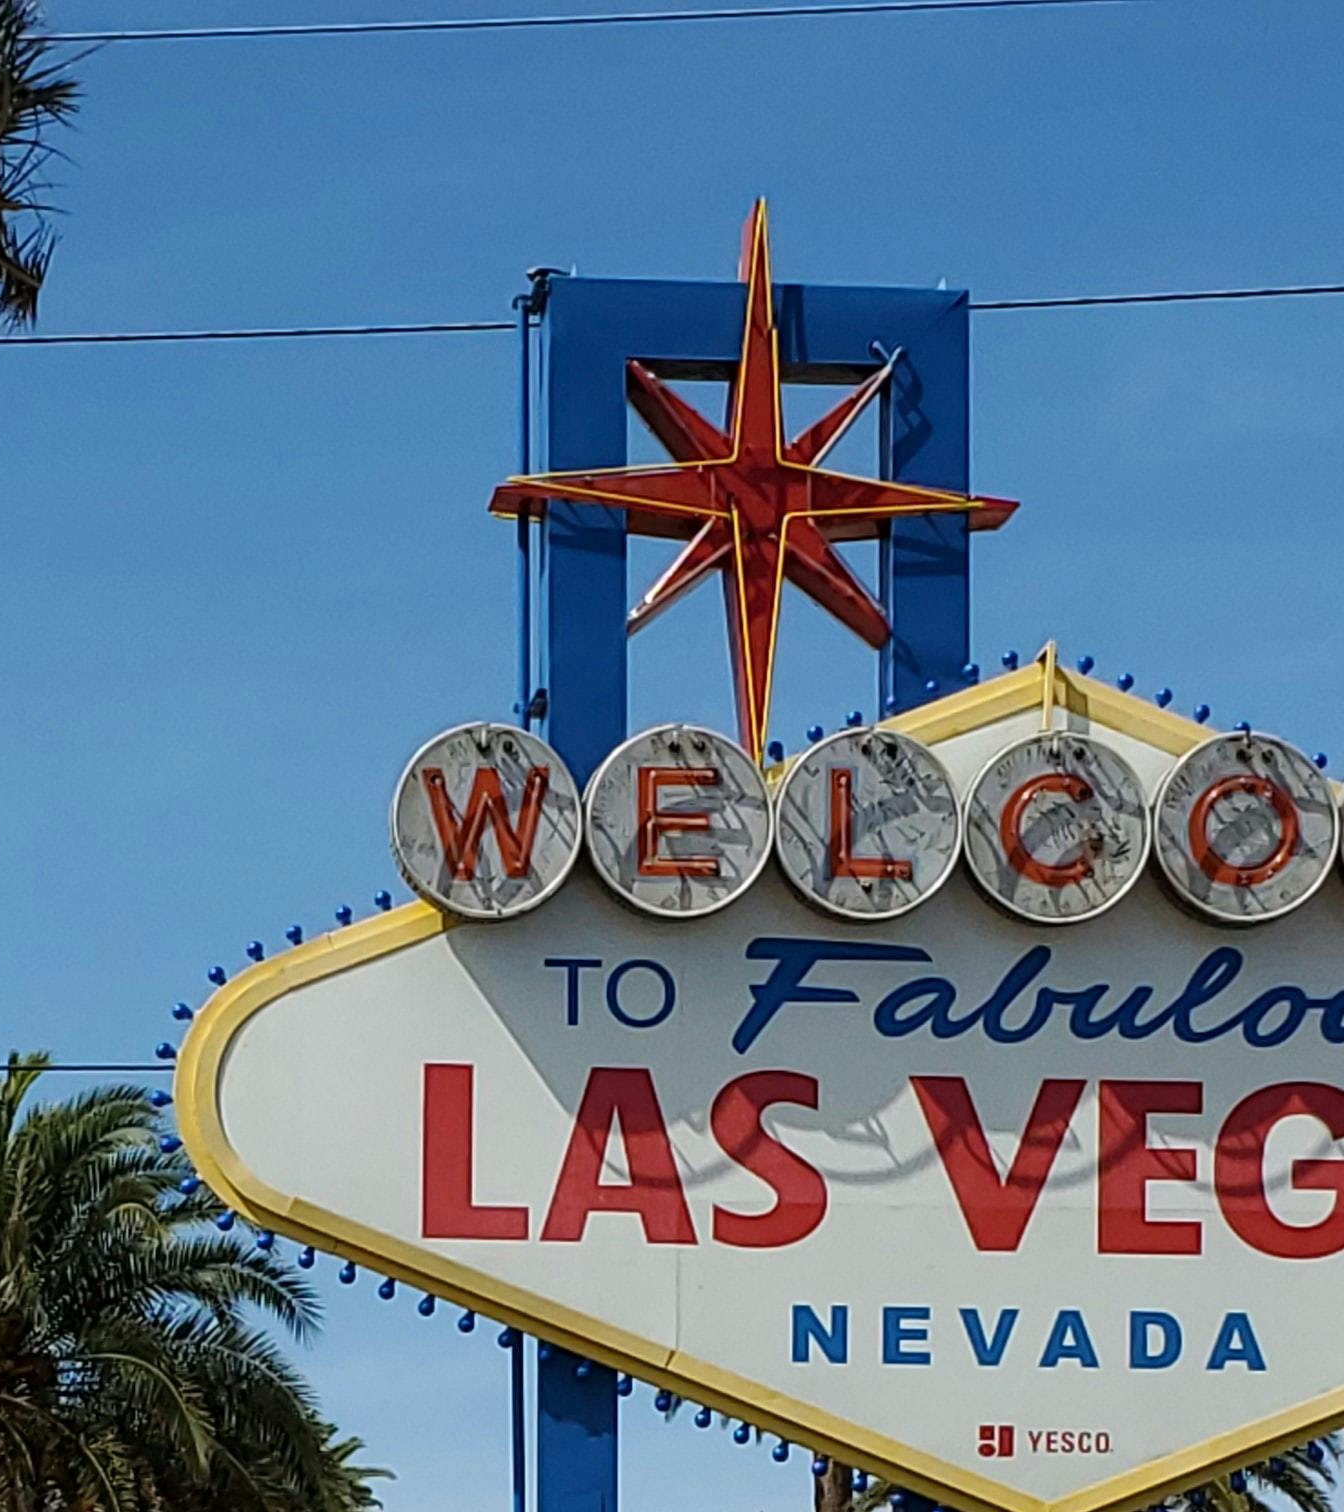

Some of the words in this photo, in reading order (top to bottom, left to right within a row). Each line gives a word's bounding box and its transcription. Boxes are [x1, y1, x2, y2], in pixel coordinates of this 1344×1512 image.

[545, 957, 676, 1028] TO
[423, 1064, 827, 1247] LAS
[793, 1304, 1266, 1371] NEVADA
[1027, 1430, 1111, 1454] YESCO
